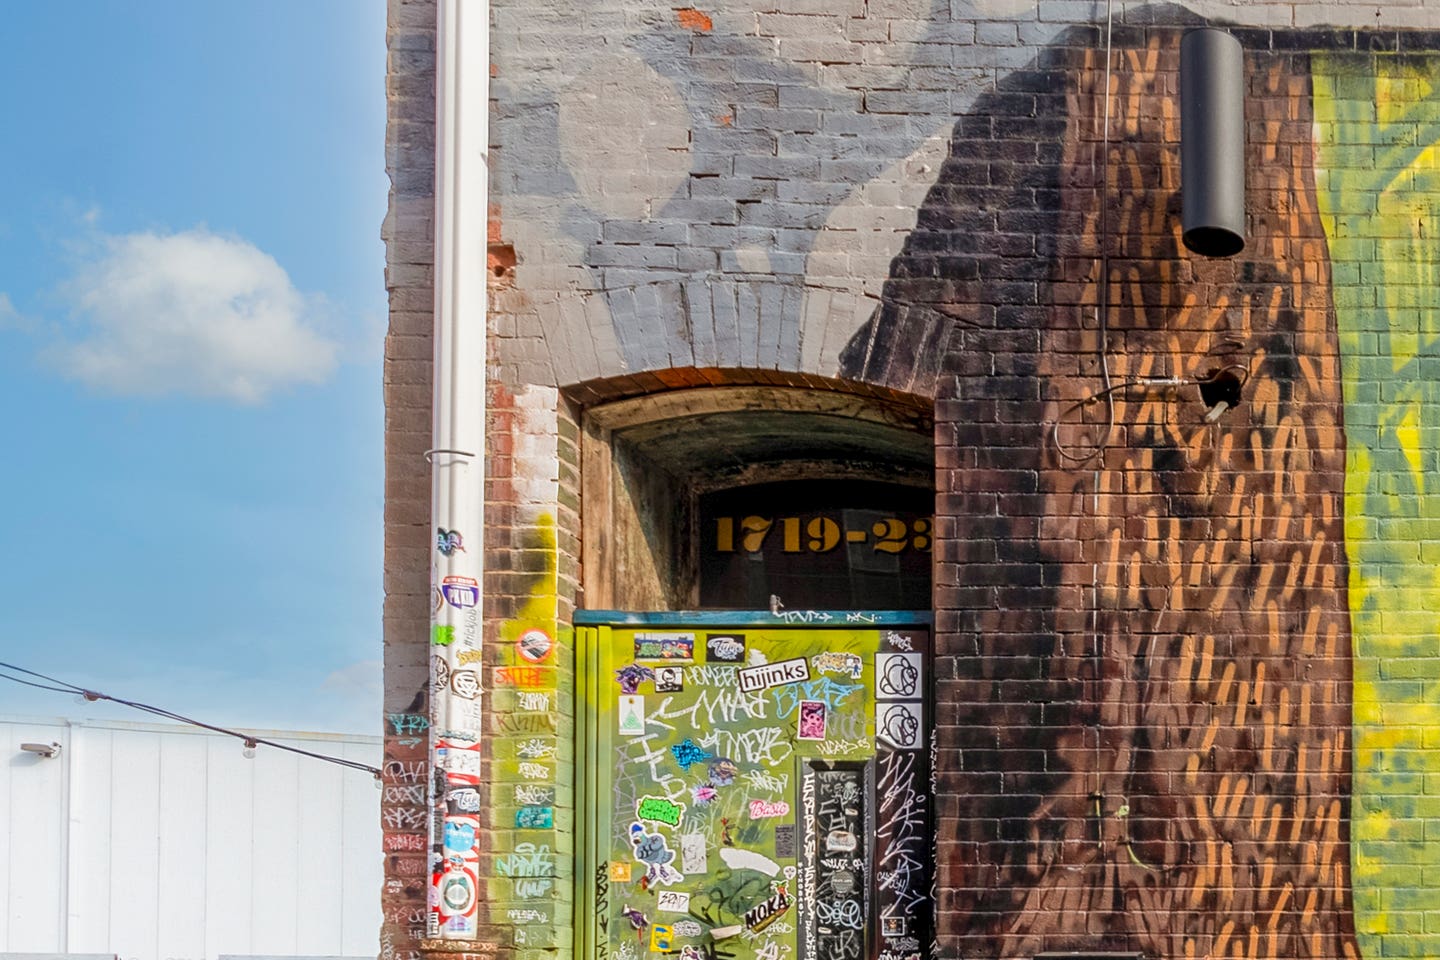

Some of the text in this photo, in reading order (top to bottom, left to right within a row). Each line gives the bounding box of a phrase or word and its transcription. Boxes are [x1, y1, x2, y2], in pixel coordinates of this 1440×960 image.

[742, 659, 807, 687] hijinks
[750, 800, 789, 819] Basic
[744, 892, 788, 930] MOKA
